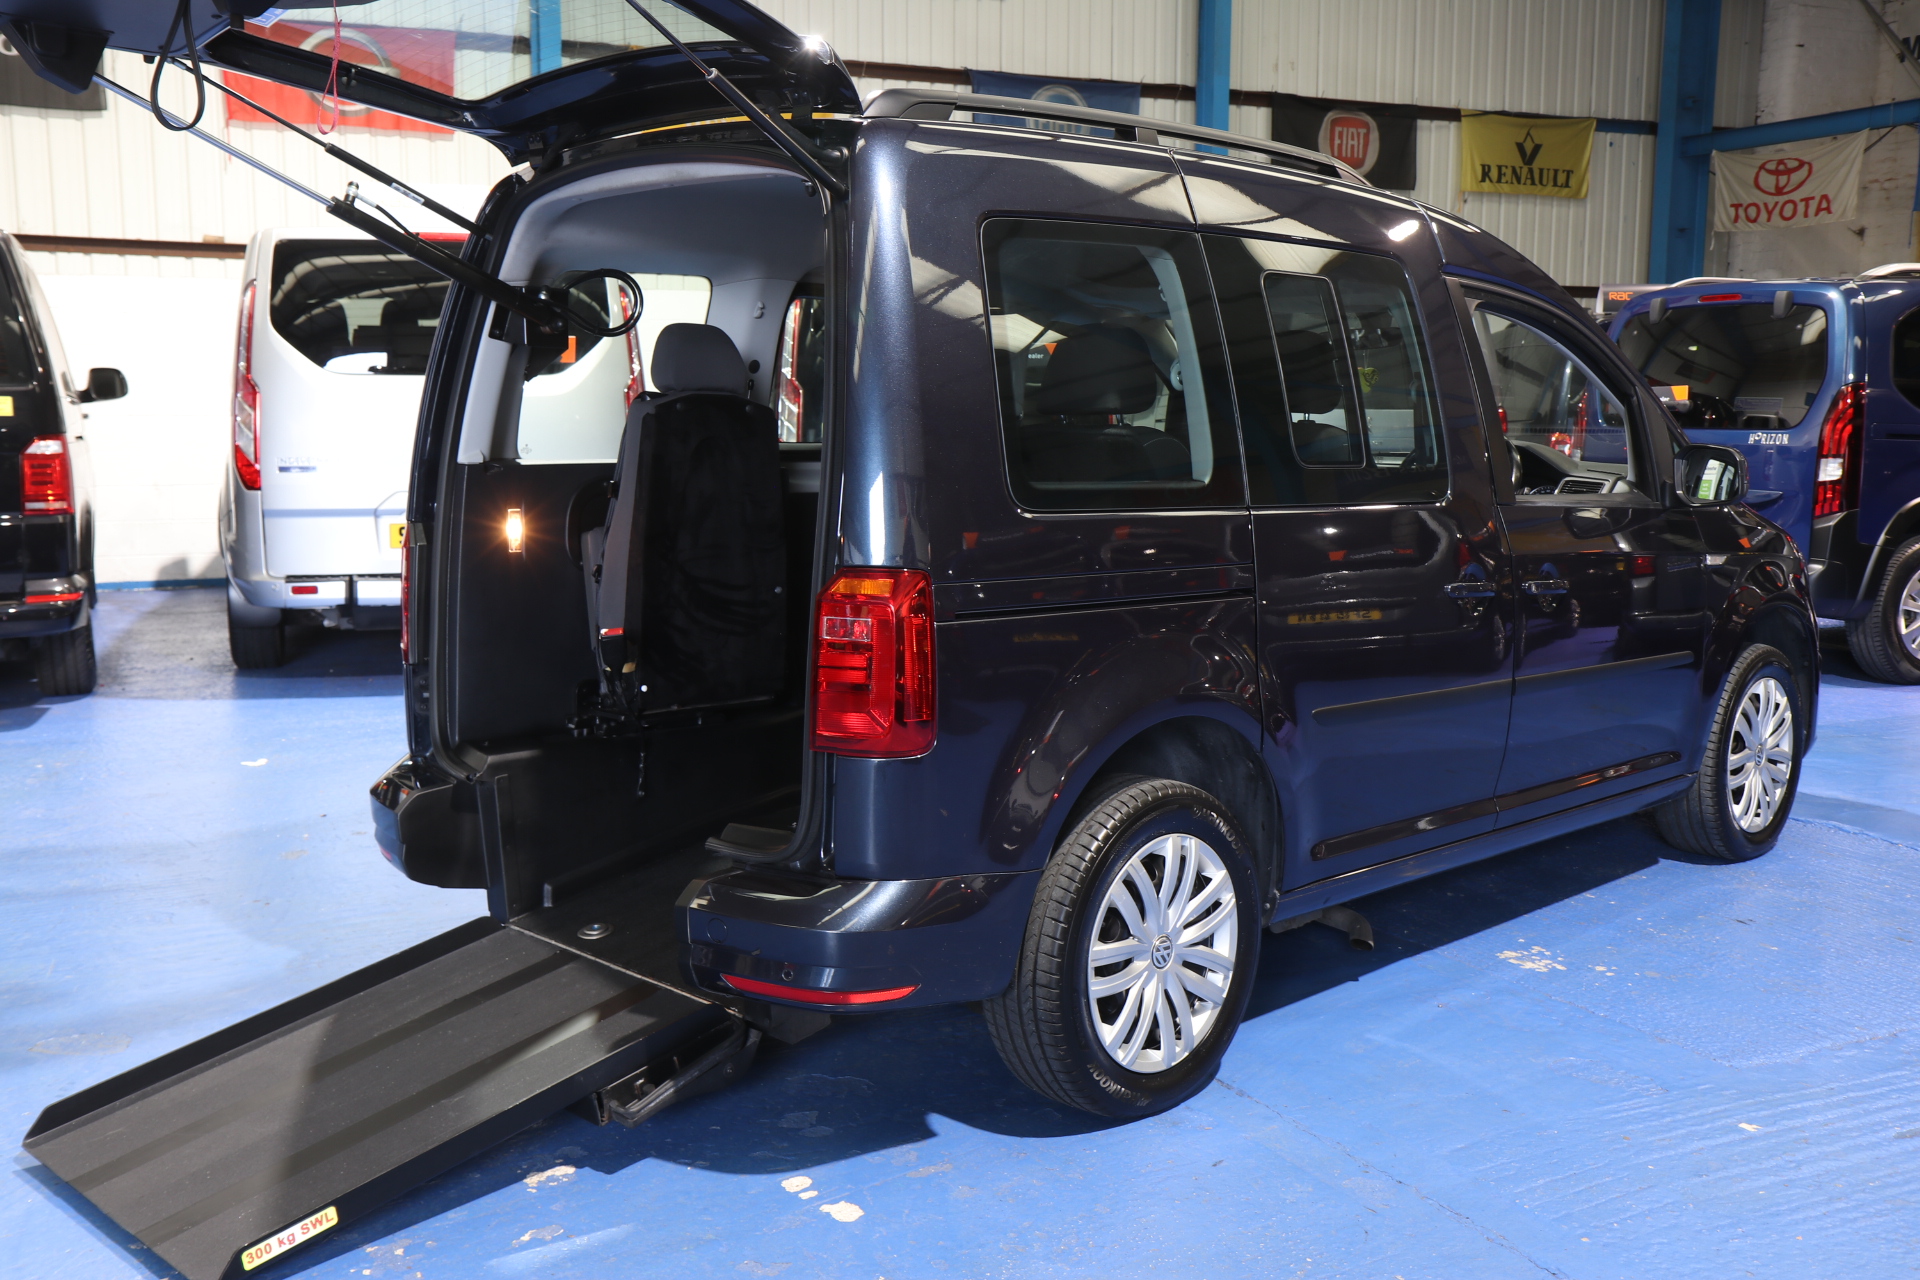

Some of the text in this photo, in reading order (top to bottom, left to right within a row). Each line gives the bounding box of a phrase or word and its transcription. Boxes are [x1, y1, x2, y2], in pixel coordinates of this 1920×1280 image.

[1333, 126, 1367, 158] FIAT
[1479, 164, 1574, 188] RENAULT
[1730, 194, 1833, 224] TOYOTA
[1748, 432, 1789, 445] HORIZON
[246, 1212, 334, 1264] 300 kg SWL
